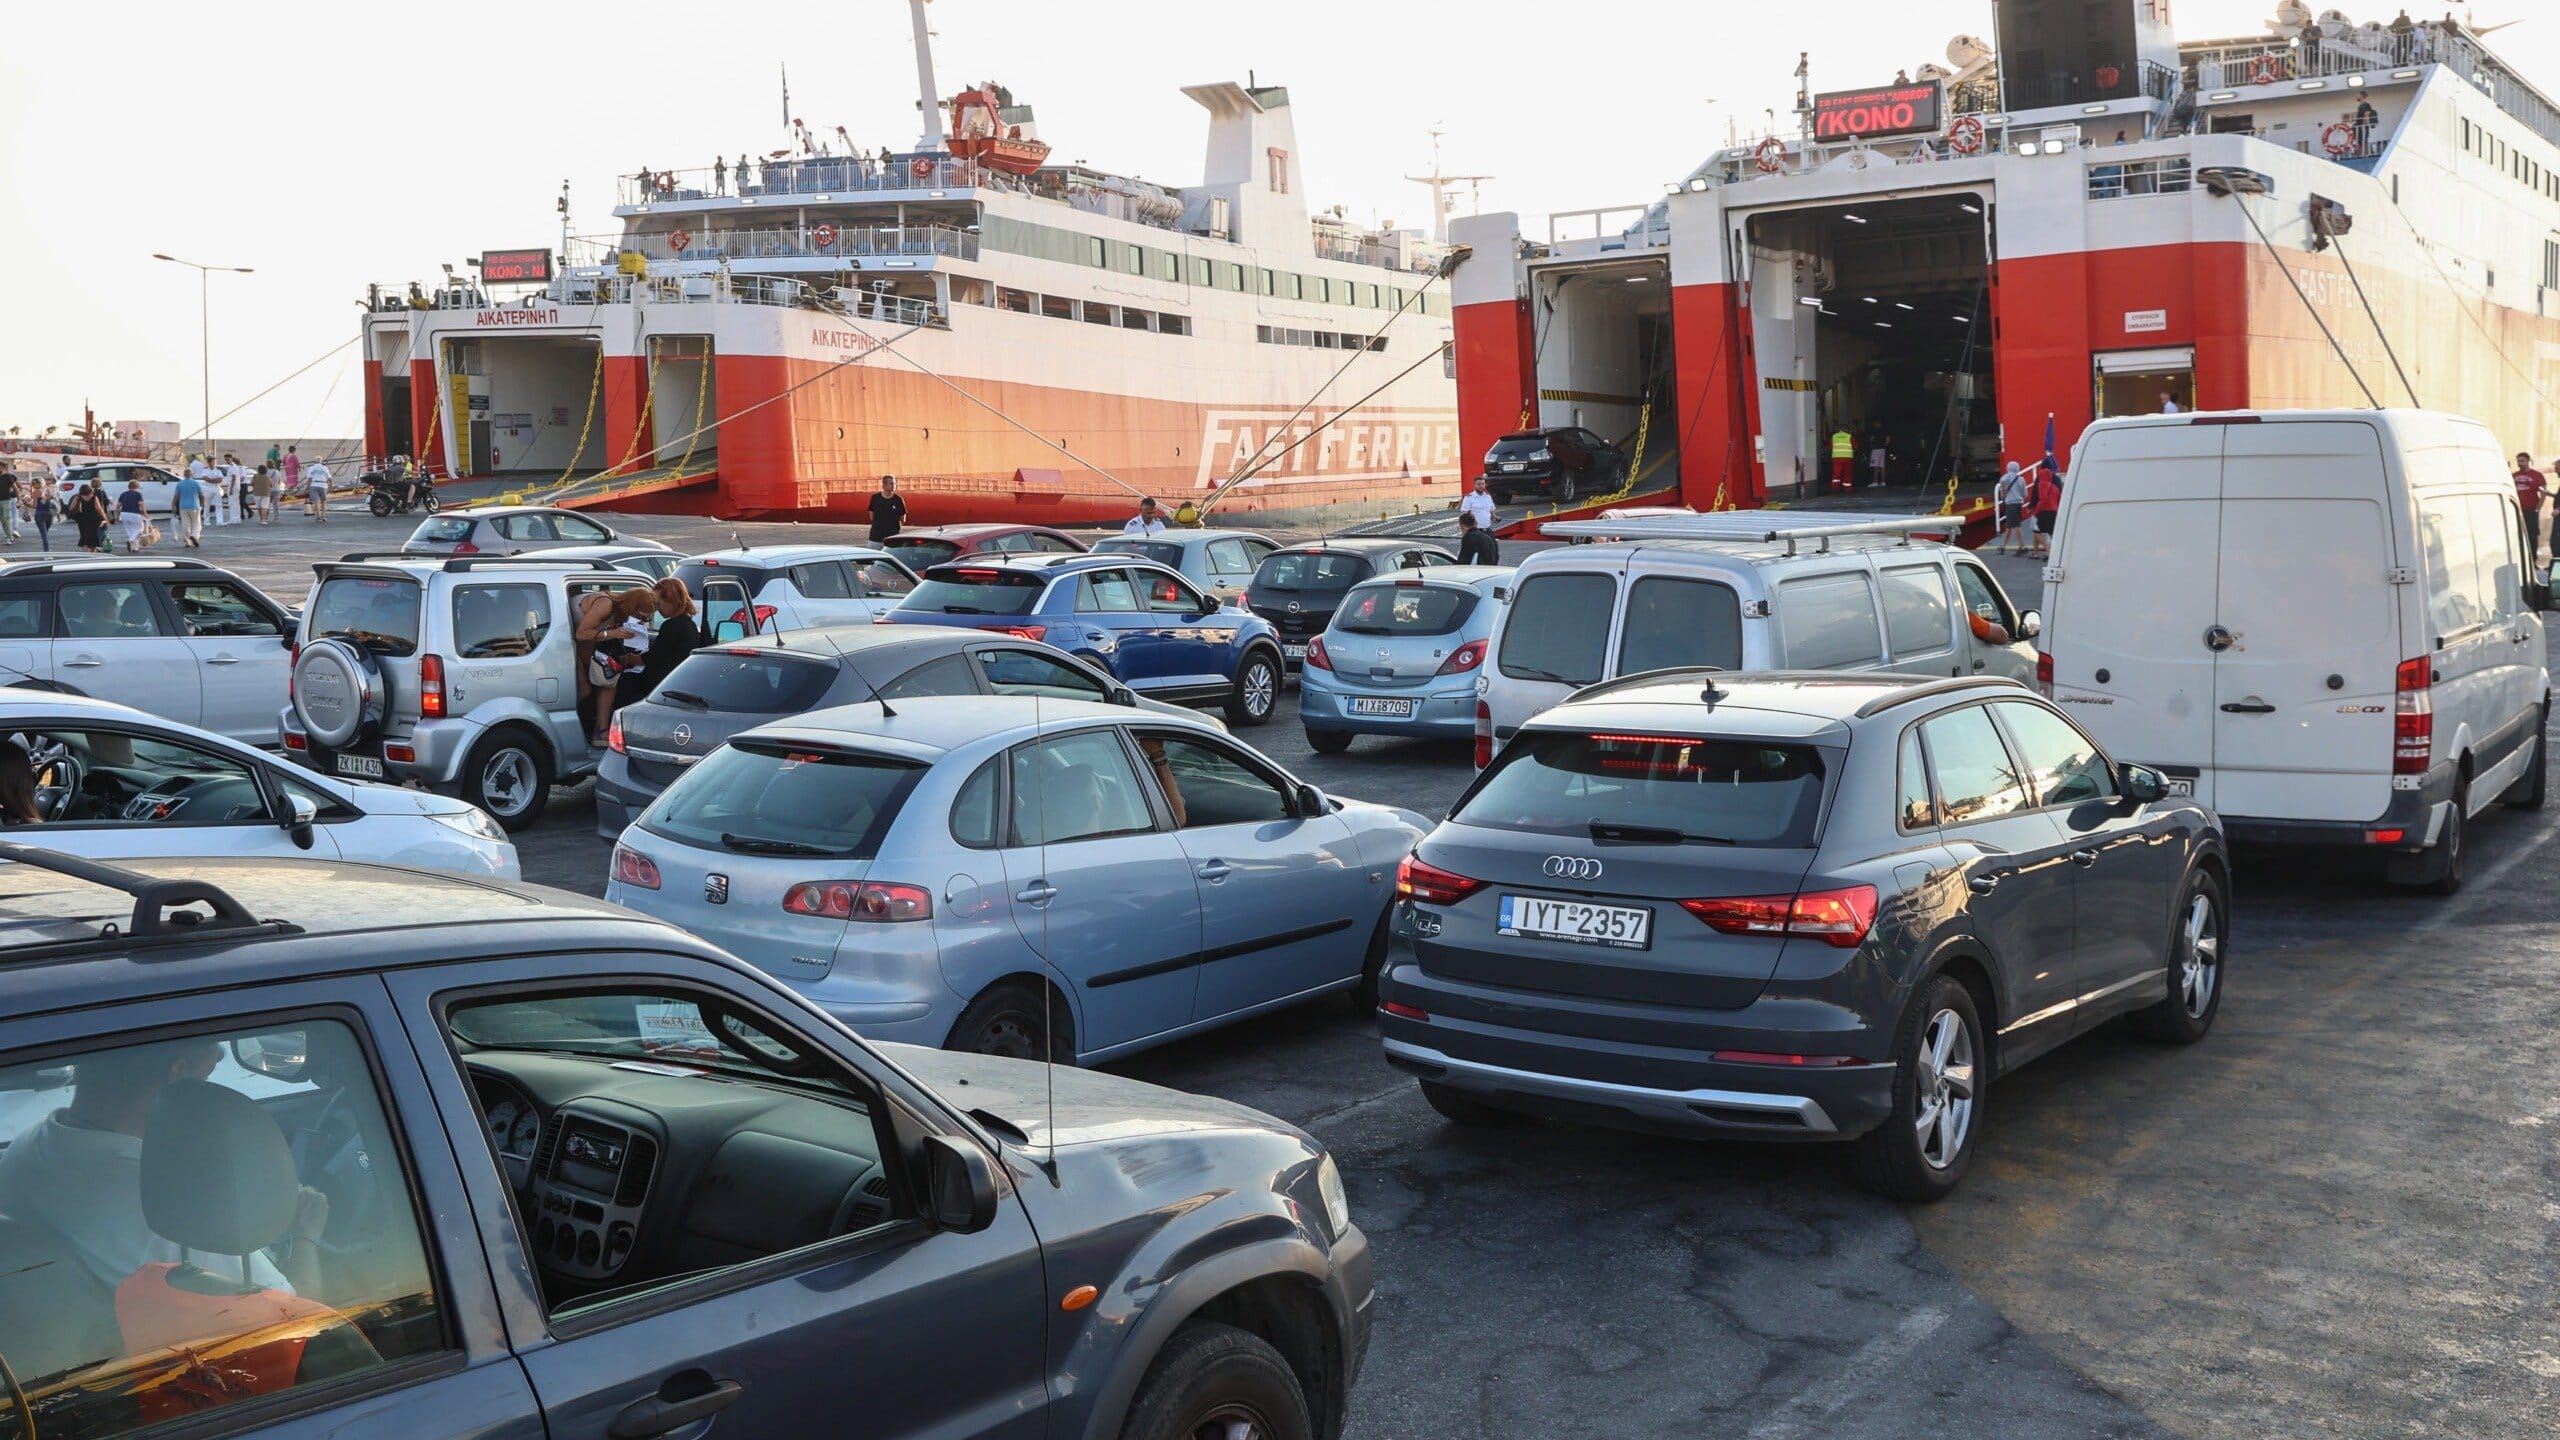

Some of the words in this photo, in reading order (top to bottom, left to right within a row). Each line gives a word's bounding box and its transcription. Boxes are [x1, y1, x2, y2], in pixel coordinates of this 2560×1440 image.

[549, 309, 558, 324] Π
[1193, 410, 1315, 489] FAST
[1500, 915, 1511, 923] GR
[1540, 932, 1599, 943] www.arenagr.com
